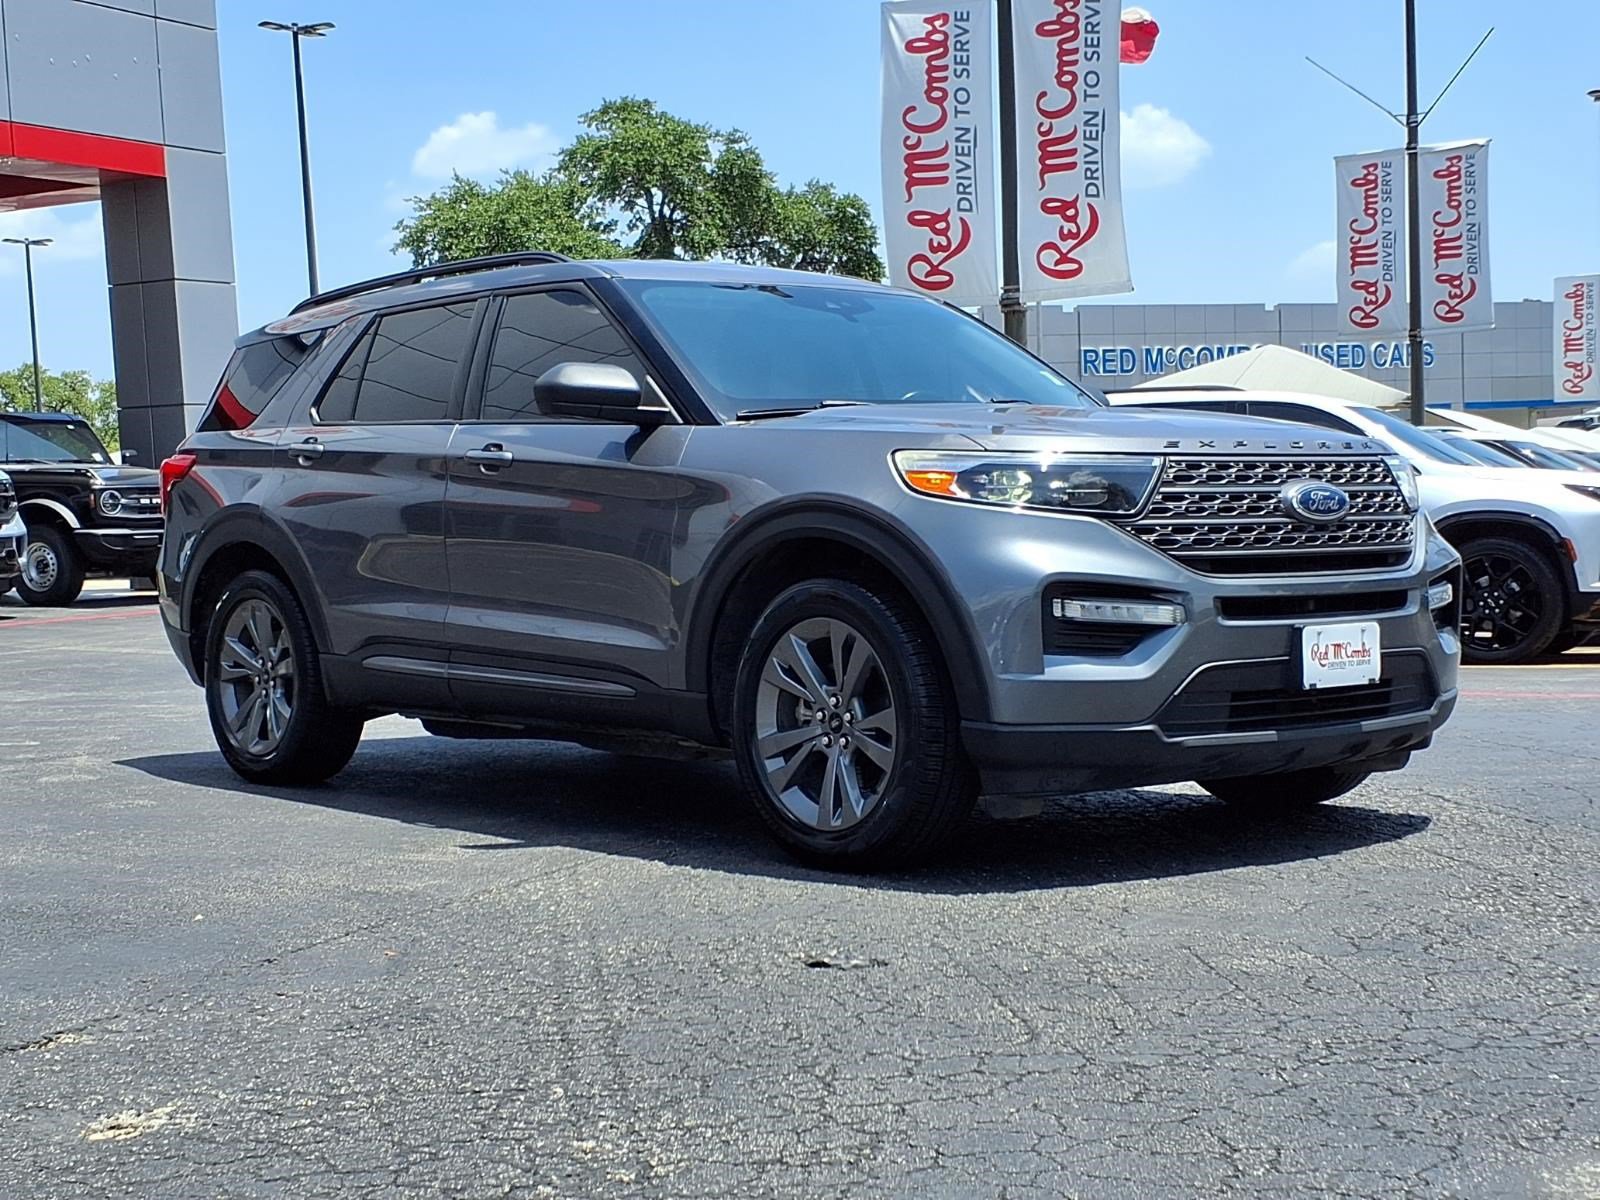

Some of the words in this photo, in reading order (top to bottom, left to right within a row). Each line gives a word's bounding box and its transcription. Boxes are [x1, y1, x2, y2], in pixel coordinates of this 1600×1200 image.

[954, 10, 970, 79] SERVE
[1084, 0, 1101, 64] SERV
[902, 12, 950, 203] McCombs
[954, 87, 971, 120] TO
[1084, 70, 1100, 102] TO
[955, 128, 974, 213] DRIVEN
[1084, 110, 1101, 199] DRIVEN
[1465, 153, 1476, 195] SERVE
[1381, 161, 1392, 203] SERVE
[1349, 162, 1379, 276] McCombs
[1382, 206, 1392, 227] TO
[1432, 154, 1463, 270] McCombs
[1465, 198, 1476, 219] TO
[907, 207, 972, 291] Red
[1036, 194, 1100, 280] Red
[1383, 232, 1394, 282] DRIVEN
[1466, 223, 1478, 275] DRIVEN
[1349, 280, 1392, 328] Red
[1434, 272, 1476, 323] Red
[1586, 282, 1594, 311] SERVE
[1562, 282, 1585, 362] McCombs
[1586, 312, 1594, 327] TO
[1082, 347, 1137, 376] RED
[1143, 344, 1262, 375] McCO
[1586, 328, 1594, 363] DRIVEN
[1562, 362, 1592, 395] Red
[1163, 440, 1373, 450] EXPLORER
[1308, 490, 1340, 511] Ford
[1311, 643, 1329, 667] Red
[1330, 641, 1371, 660] McCombs
